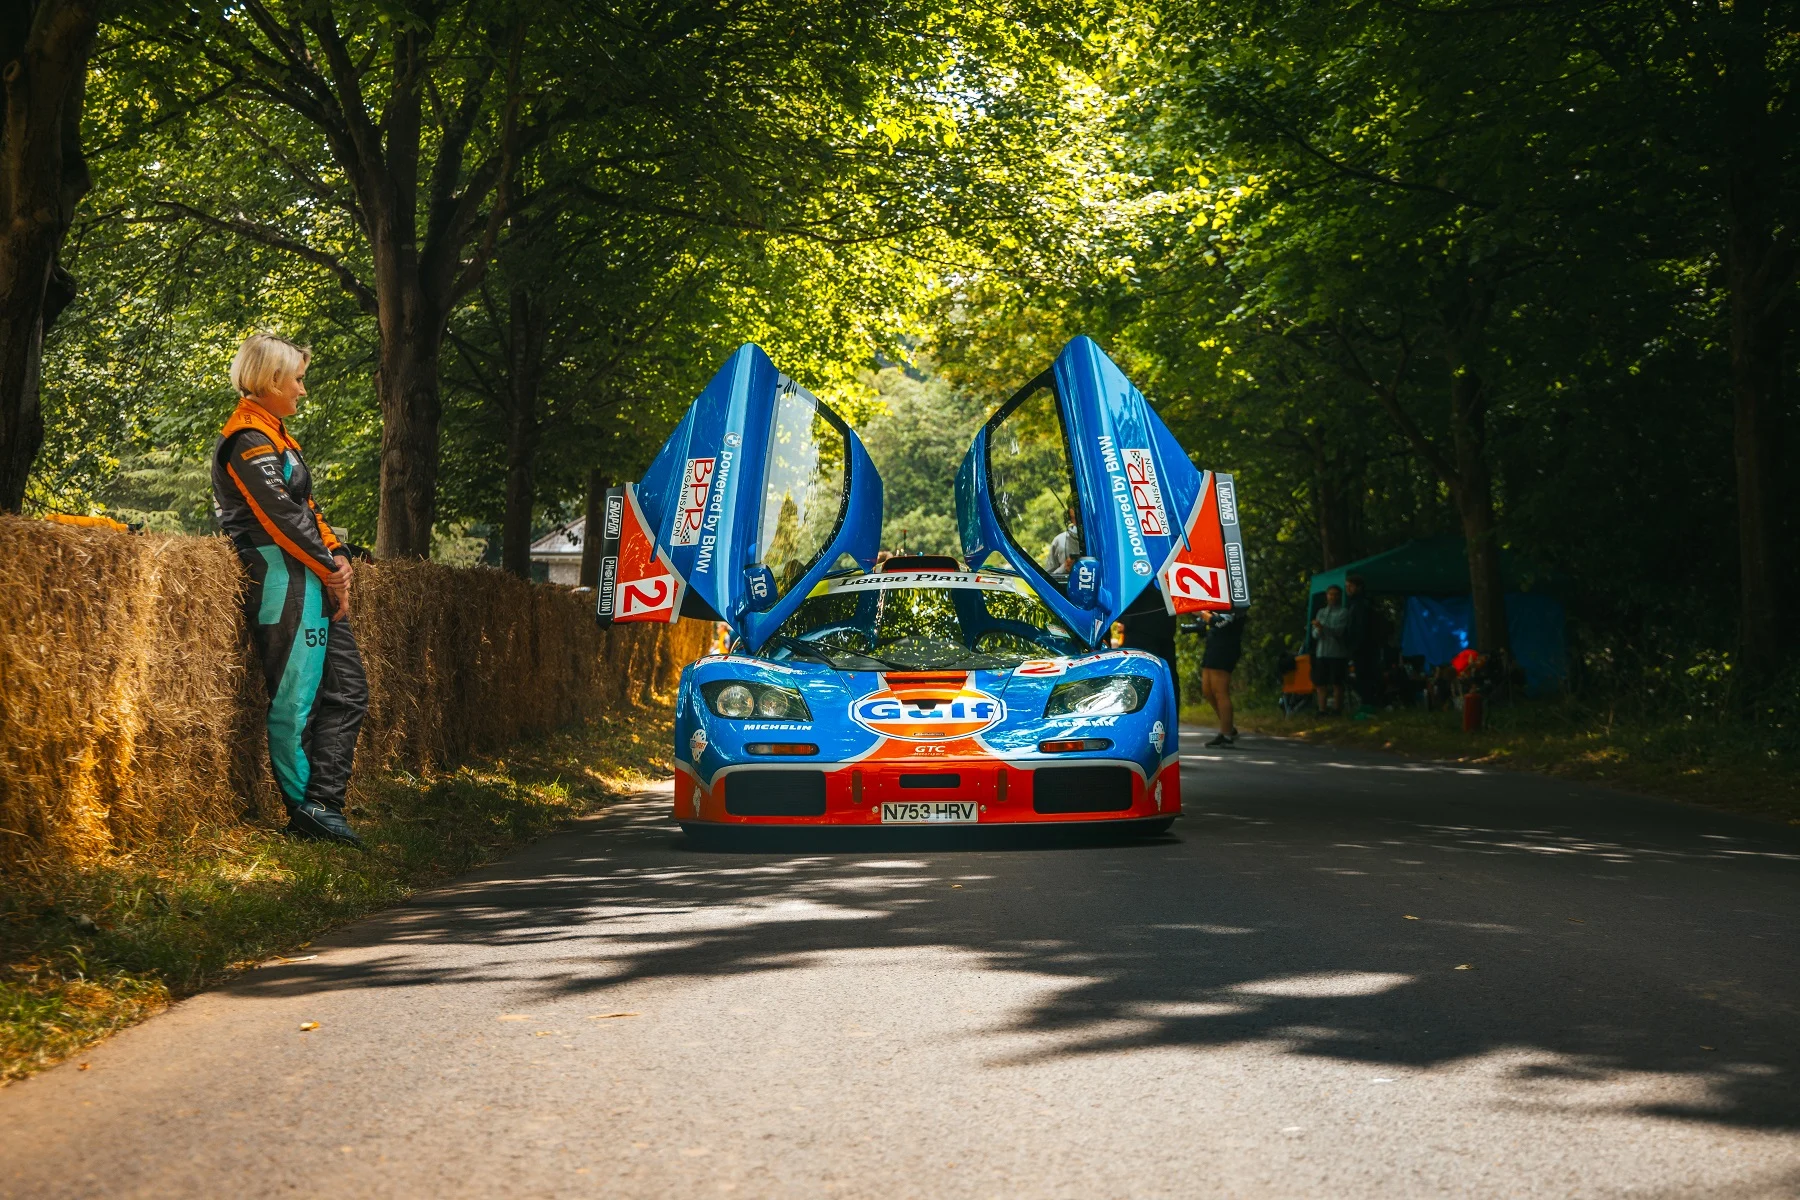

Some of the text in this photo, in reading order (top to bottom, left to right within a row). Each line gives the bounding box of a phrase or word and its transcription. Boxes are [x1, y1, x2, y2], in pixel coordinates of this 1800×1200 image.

[673, 460, 694, 537] ORGANISATION
[680, 459, 714, 537] BPR
[1097, 435, 1147, 556] powered by BMW
[1127, 457, 1162, 535] BPR
[1145, 458, 1169, 534] ORGANISATION
[695, 450, 733, 574] powered by BMW
[753, 574, 767, 597] TCP
[838, 573, 969, 586] Lease Plan
[1079, 566, 1092, 590] TCP
[1176, 567, 1220, 598] 2
[623, 580, 667, 613] 2
[305, 628, 326, 647] 58
[1020, 661, 1060, 674] 2
[883, 803, 975, 820] N753 HRV
